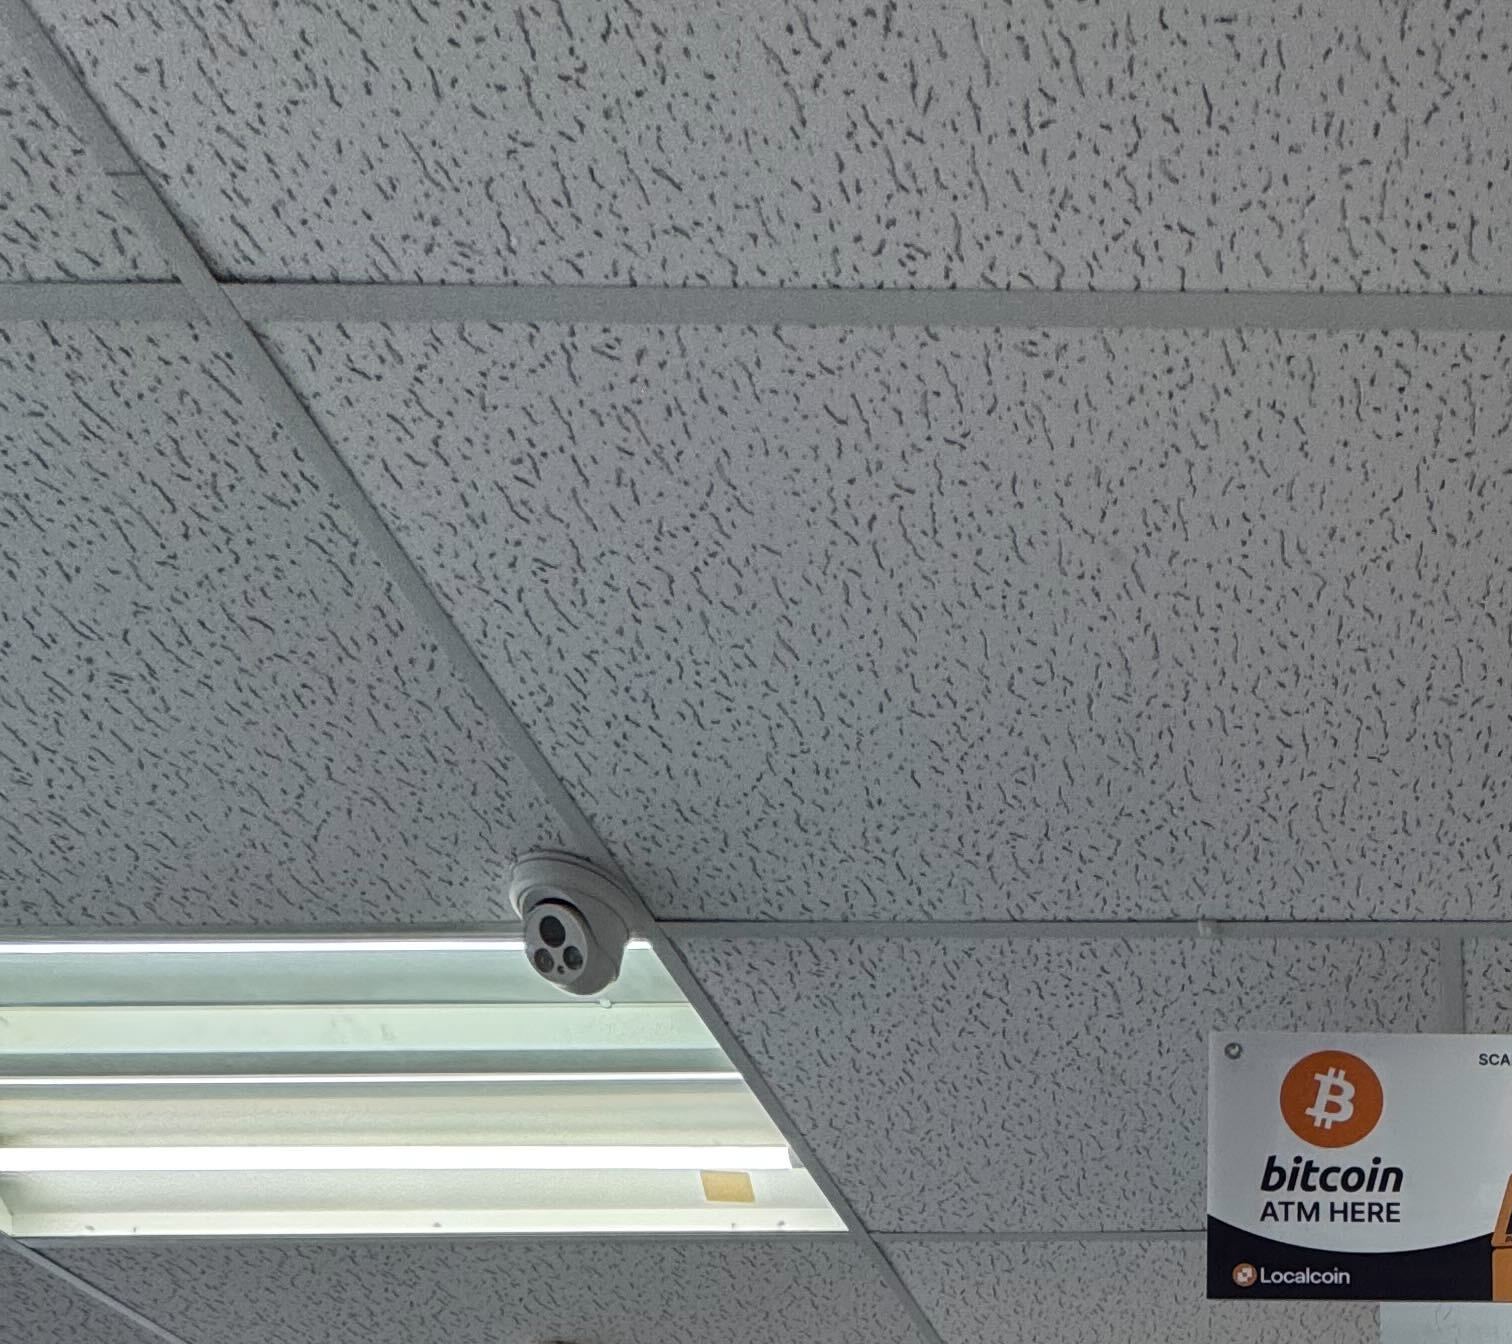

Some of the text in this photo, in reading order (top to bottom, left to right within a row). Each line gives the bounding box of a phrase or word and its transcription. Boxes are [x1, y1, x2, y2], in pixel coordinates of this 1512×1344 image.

[1260, 1155, 1404, 1193] bitcoin
[1260, 1201, 1401, 1223] ATM HERE
[1260, 1266, 1350, 1285] Localcoin
